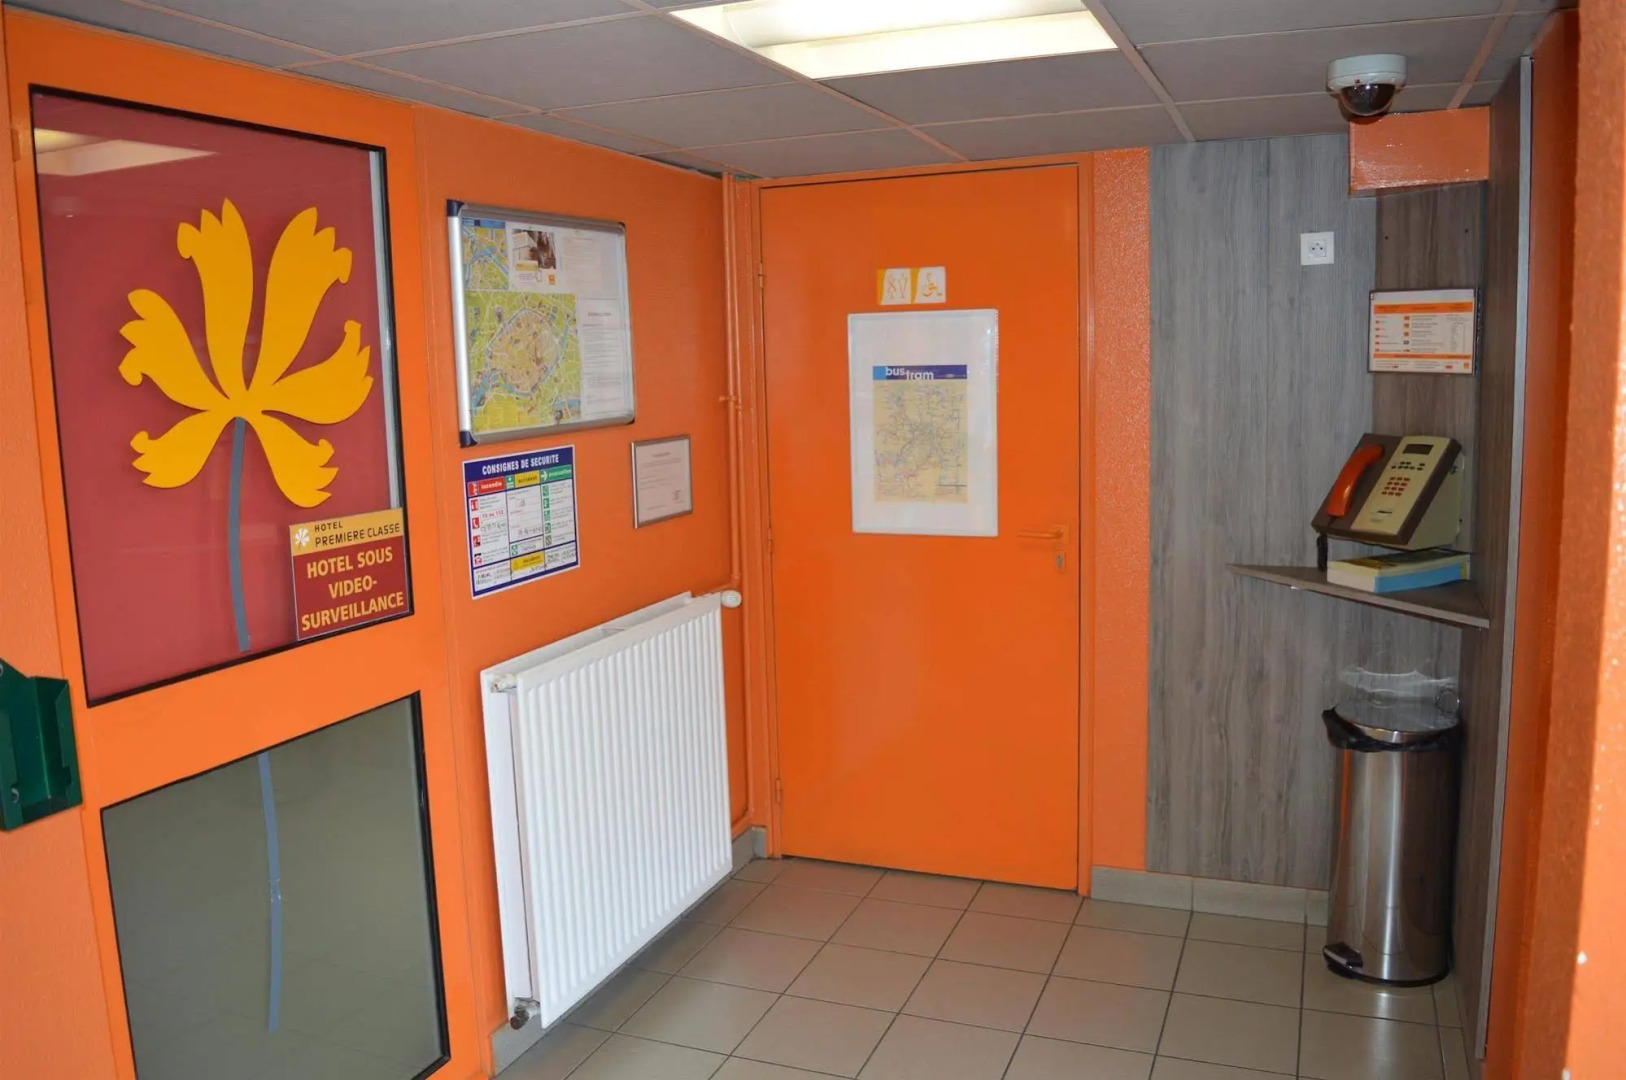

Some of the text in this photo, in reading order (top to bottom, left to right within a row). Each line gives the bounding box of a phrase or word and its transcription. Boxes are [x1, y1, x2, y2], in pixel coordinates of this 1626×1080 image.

[885, 366, 905, 376] bus
[905, 370, 934, 380] tram
[482, 454, 559, 475] CONSIGNES DE SECURITE
[480, 481, 502, 490] incendie
[315, 521, 343, 532] HOTEL
[315, 523, 400, 547] PREMIERE CLASSE
[307, 547, 393, 579] HOTEL SOUS
[328, 575, 377, 599] VIDEO-
[301, 592, 404, 631] SURVEILLANCE
